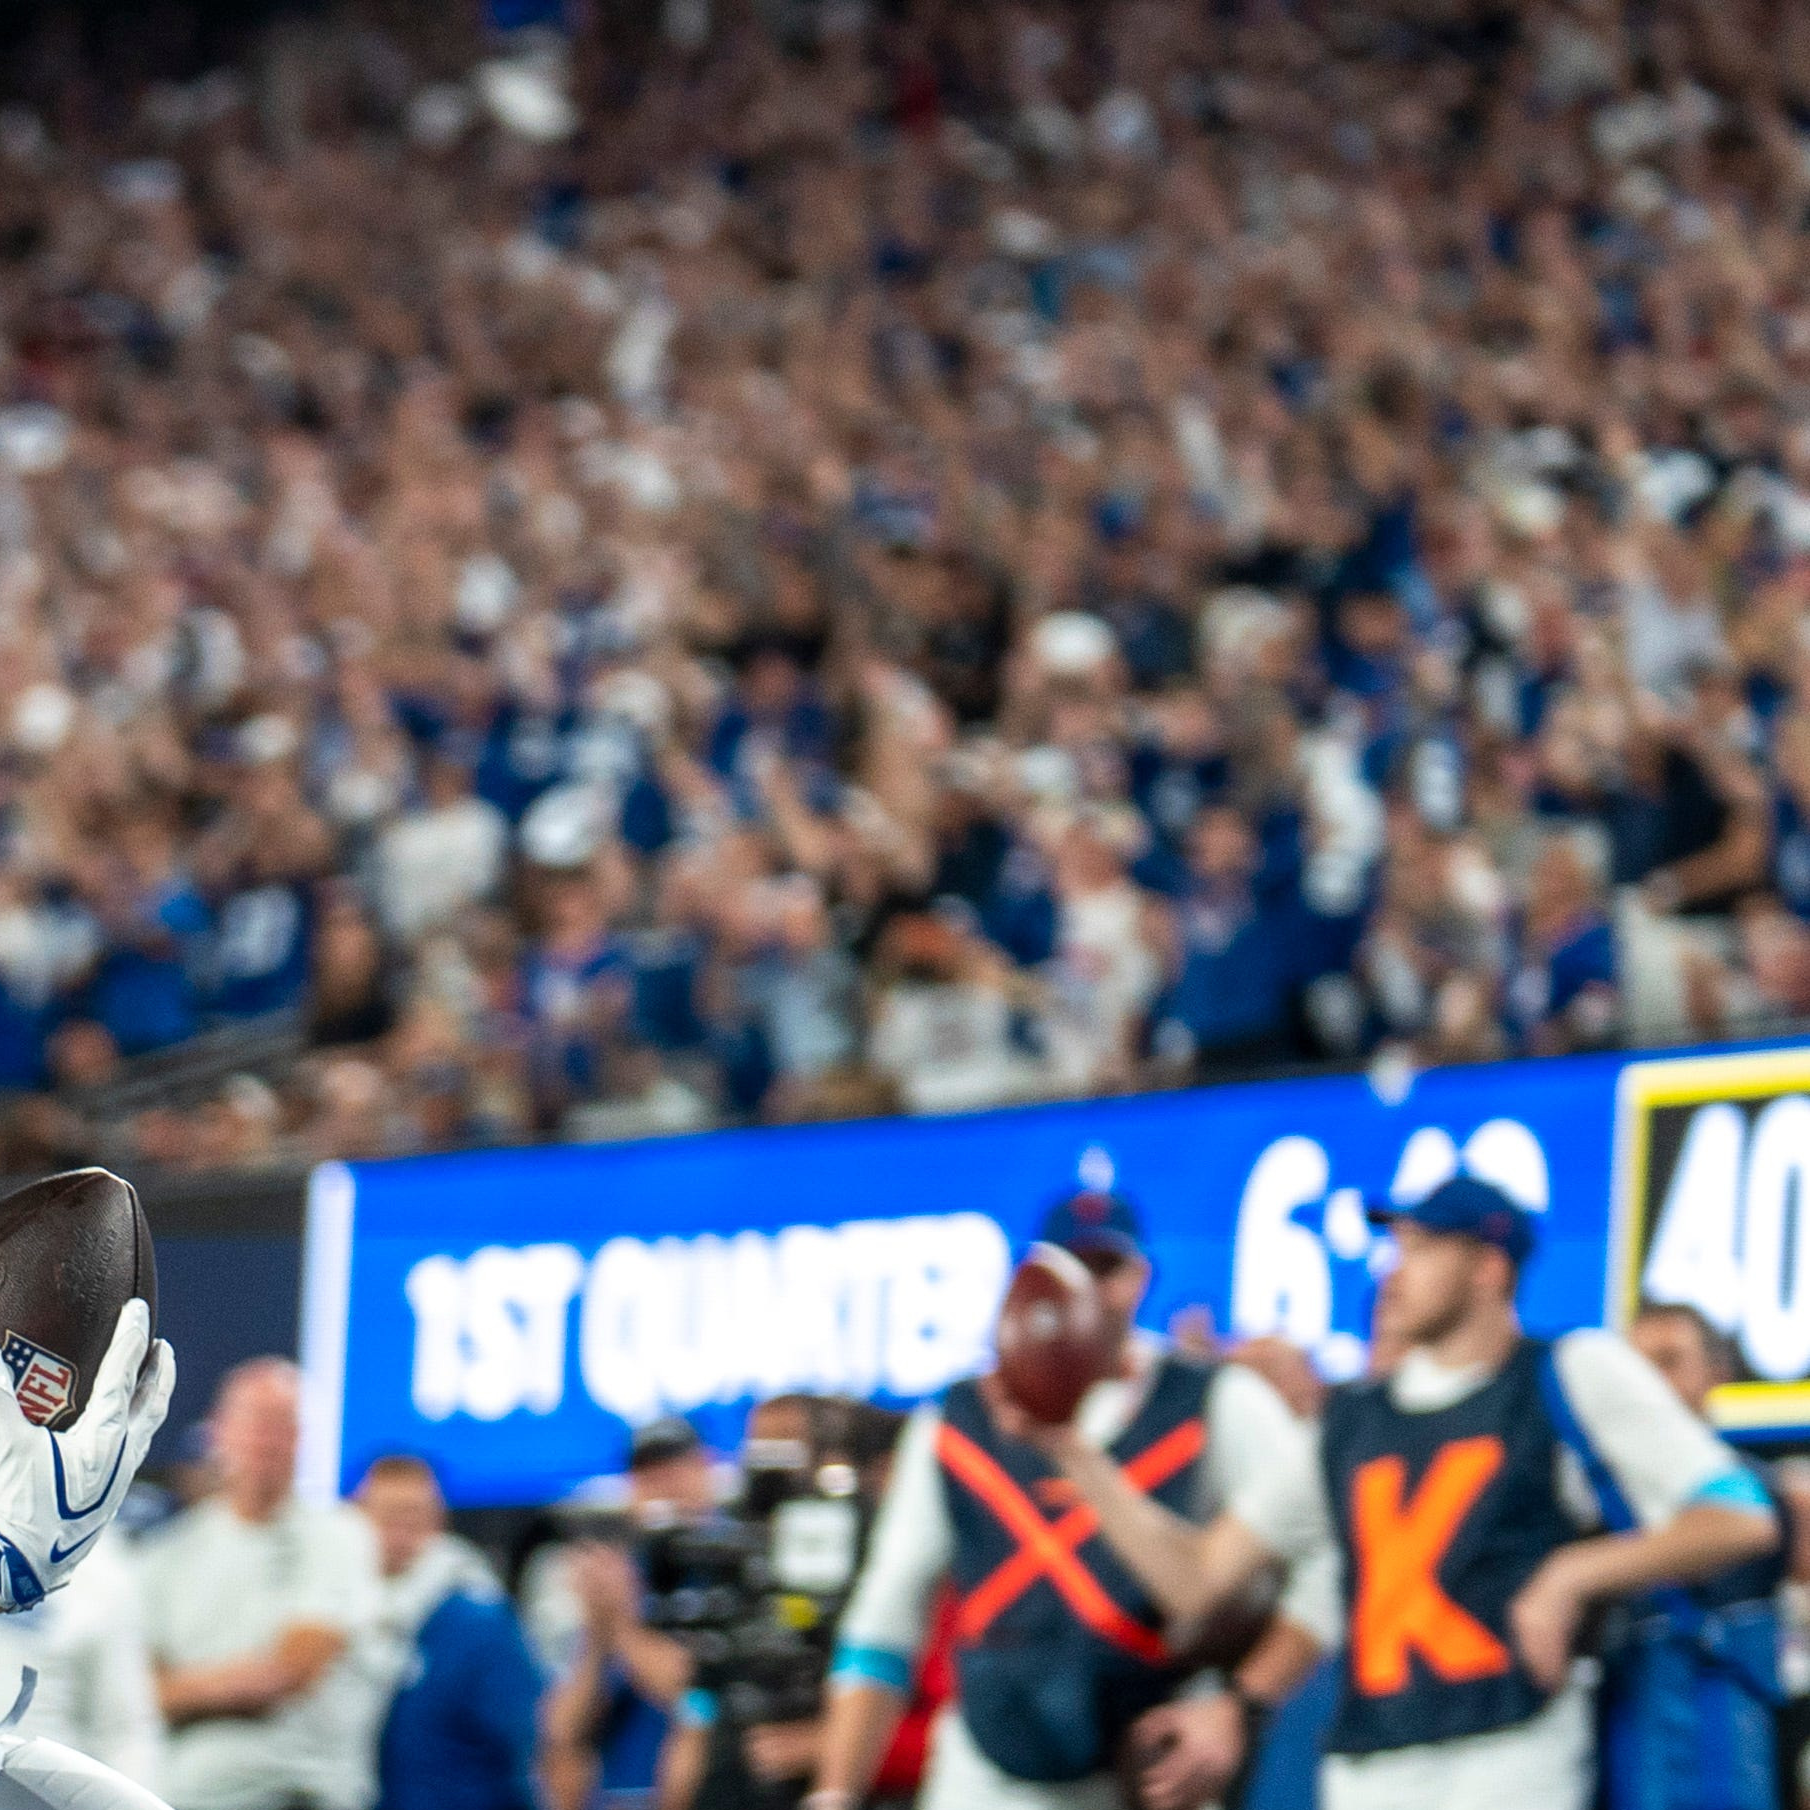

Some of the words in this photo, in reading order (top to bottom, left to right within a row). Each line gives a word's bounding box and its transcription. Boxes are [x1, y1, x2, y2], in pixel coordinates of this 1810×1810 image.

[16, 1363, 72, 1425] NFL
[406, 1243, 583, 1421] 1ST
[583, 1212, 1012, 1425] QUARTER
[1350, 1435, 1511, 1697] K
